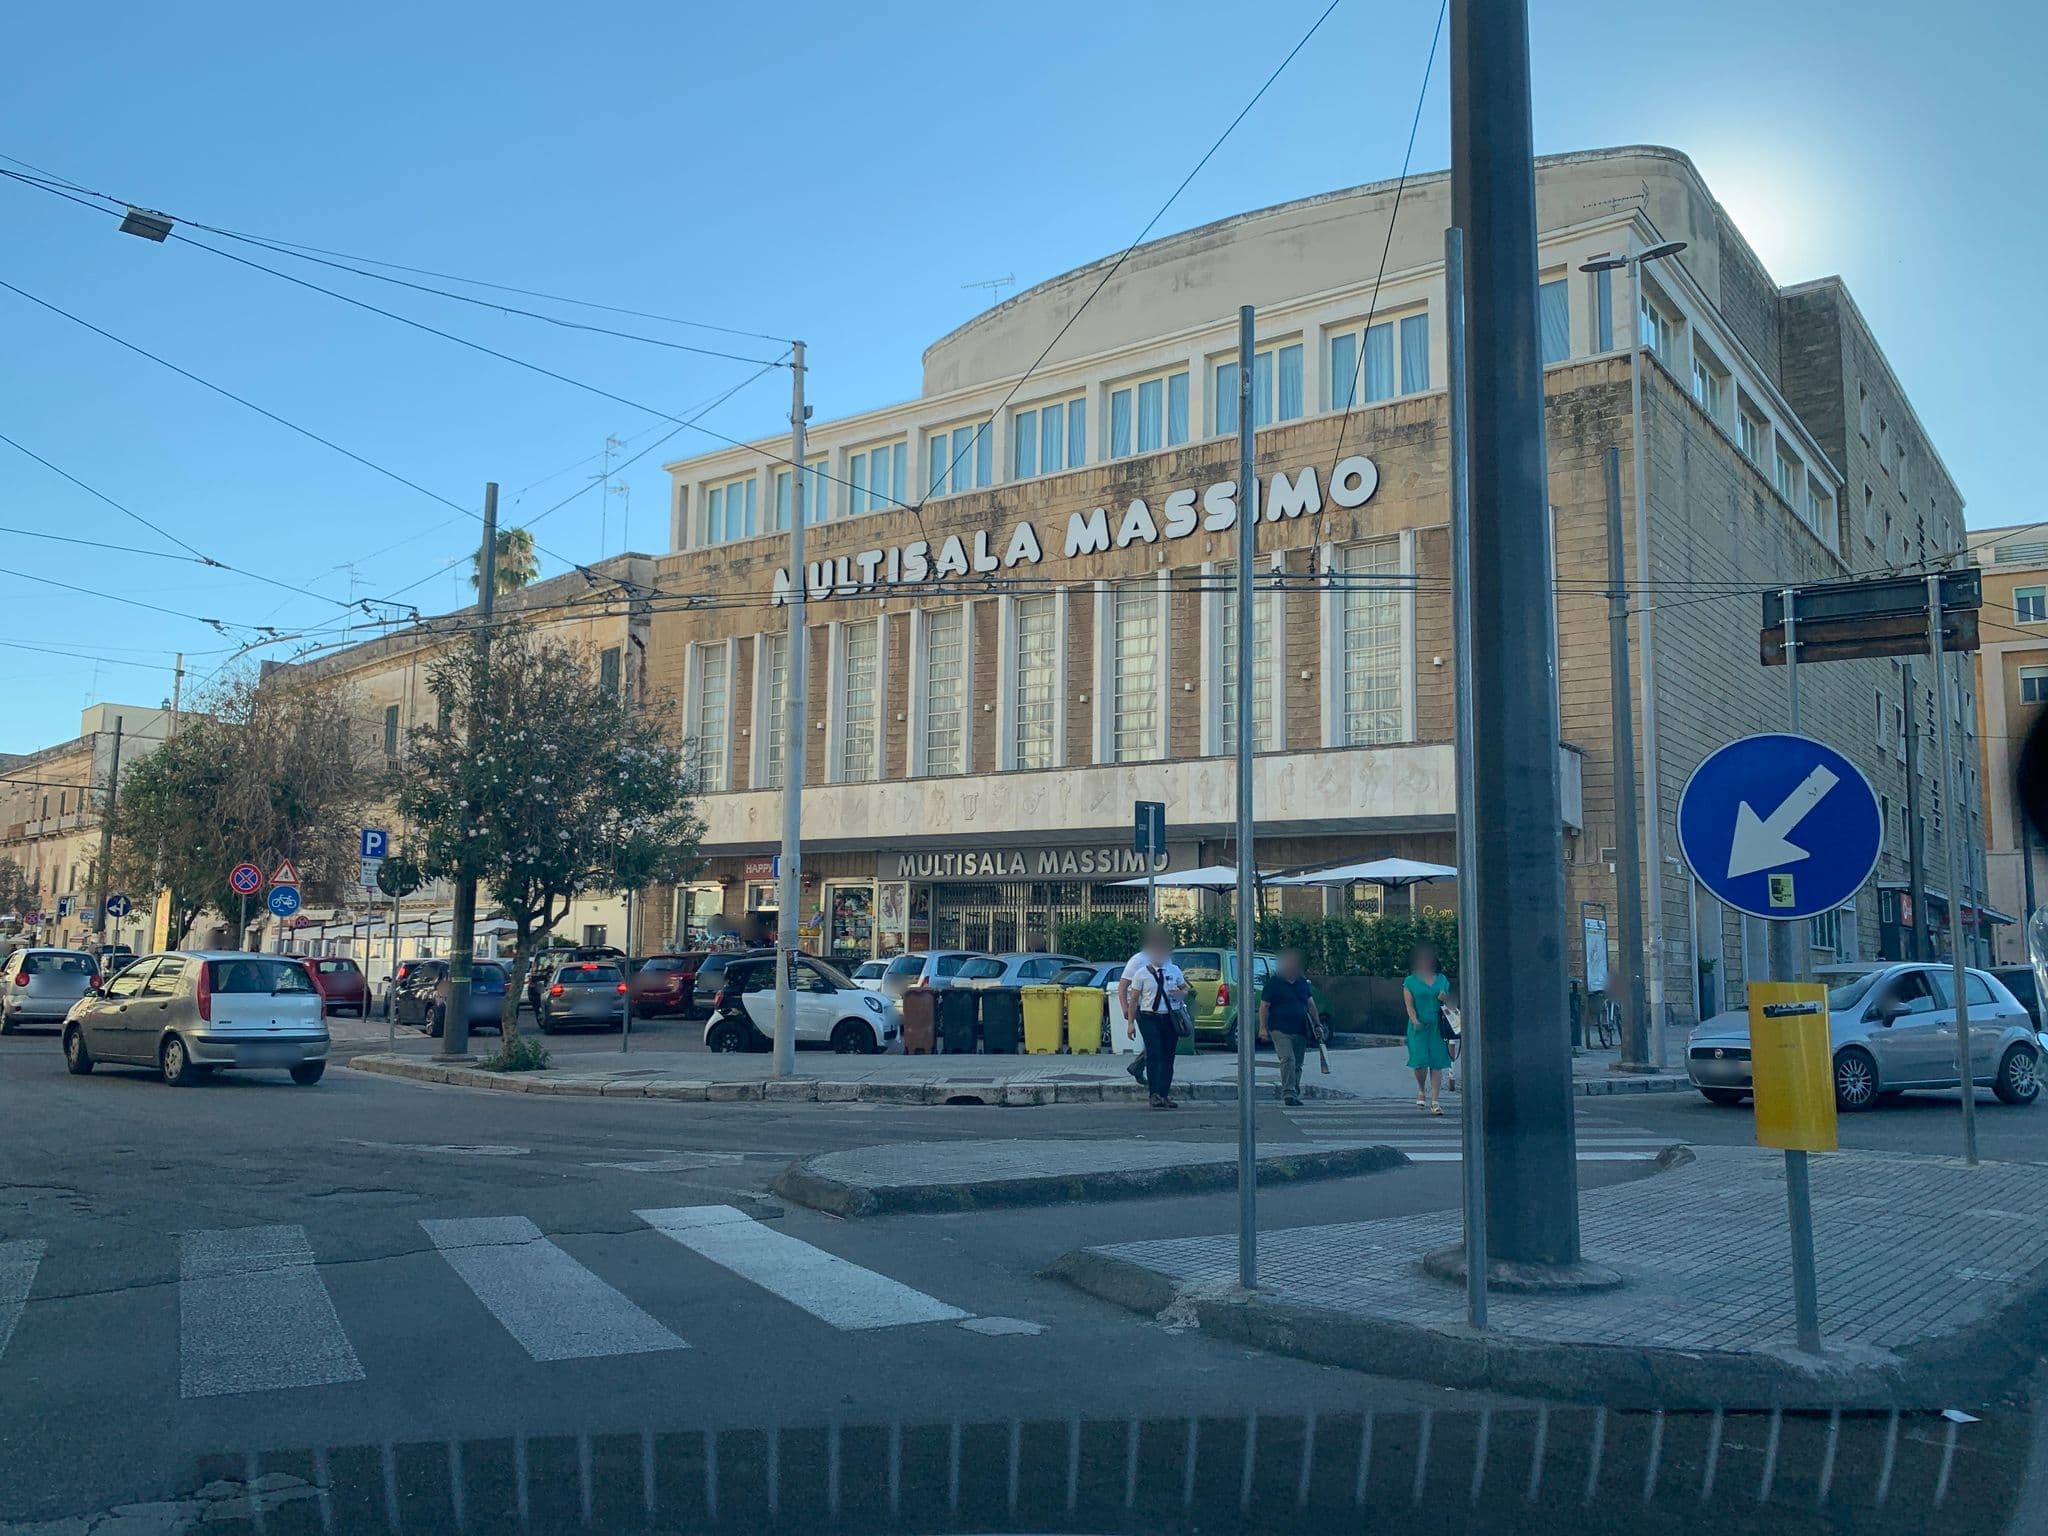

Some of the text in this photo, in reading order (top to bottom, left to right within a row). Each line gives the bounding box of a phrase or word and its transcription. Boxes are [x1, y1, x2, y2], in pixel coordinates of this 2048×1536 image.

[771, 521, 1042, 607] MULTISALA
[366, 832, 382, 855] P
[745, 863, 774, 874] HAPPY
[898, 852, 1027, 877] MULTISALA
